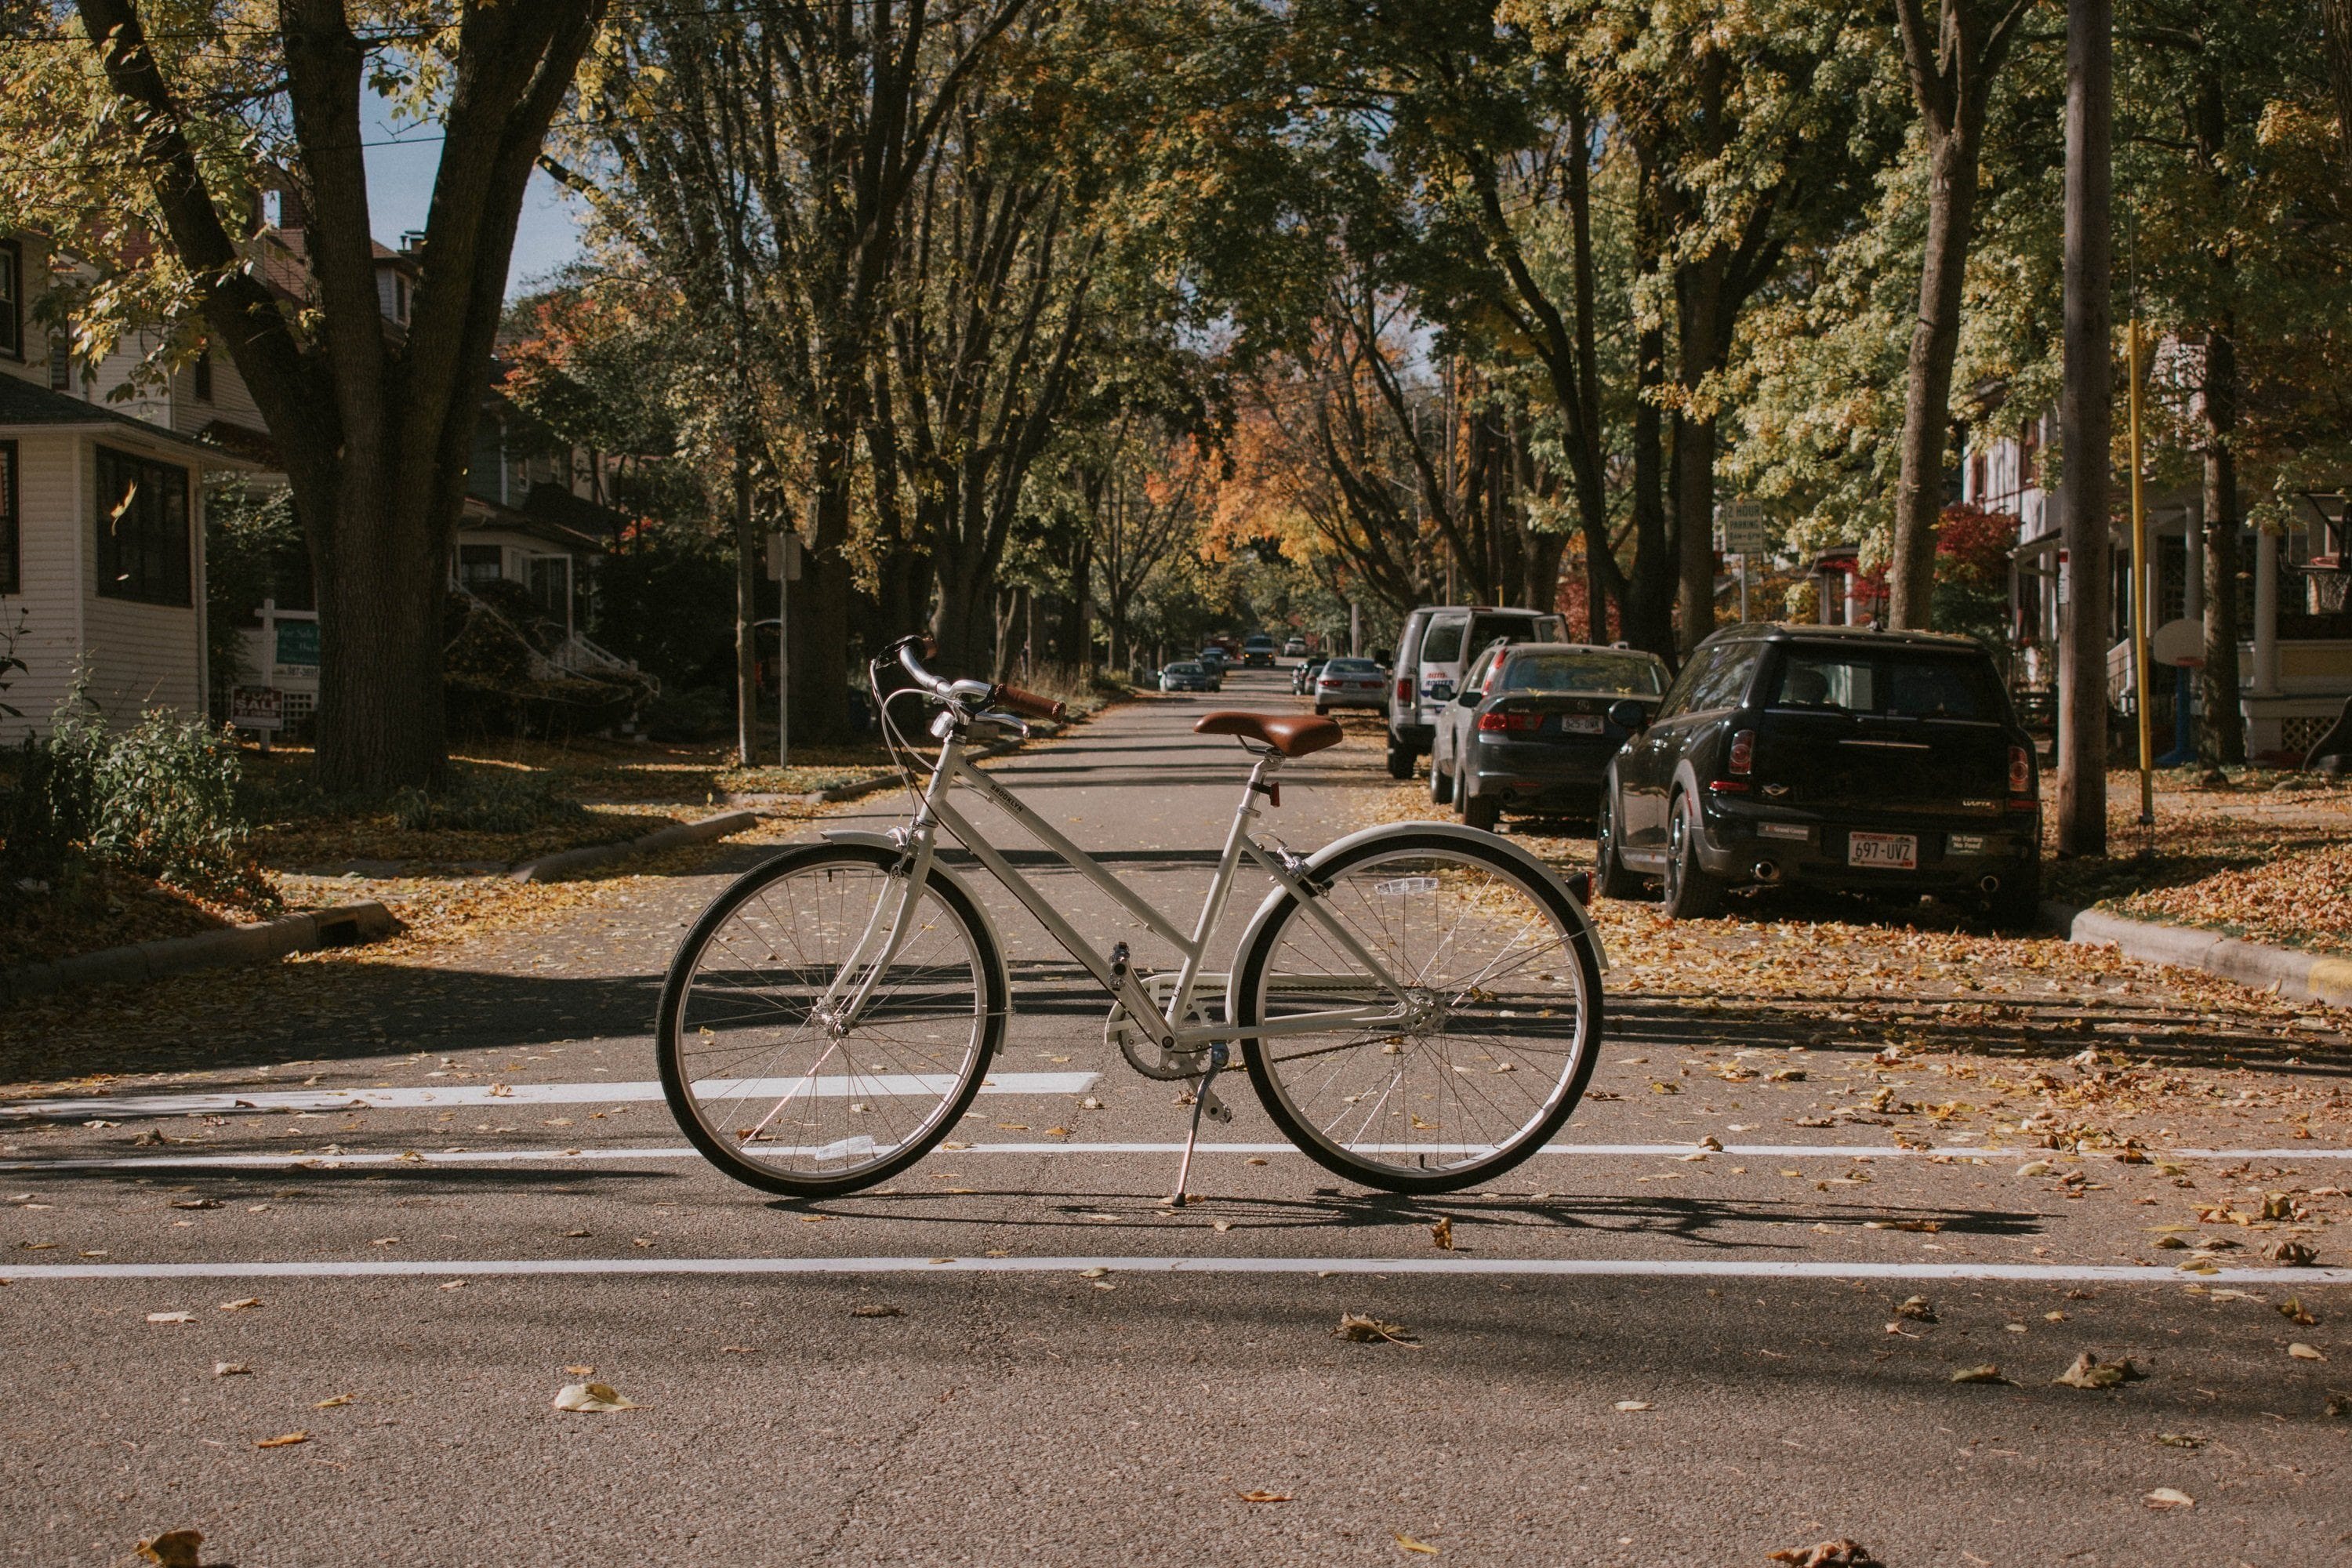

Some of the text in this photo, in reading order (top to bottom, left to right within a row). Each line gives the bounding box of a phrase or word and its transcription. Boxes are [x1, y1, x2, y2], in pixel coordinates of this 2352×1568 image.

[1727, 505, 1760, 517] 2 HOUR
[1730, 520, 1759, 529] PARKING
[235, 699, 281, 710] SALE
[990, 784, 1024, 812] BROOKLYN
[1855, 842, 1911, 860] 697-UVZ
